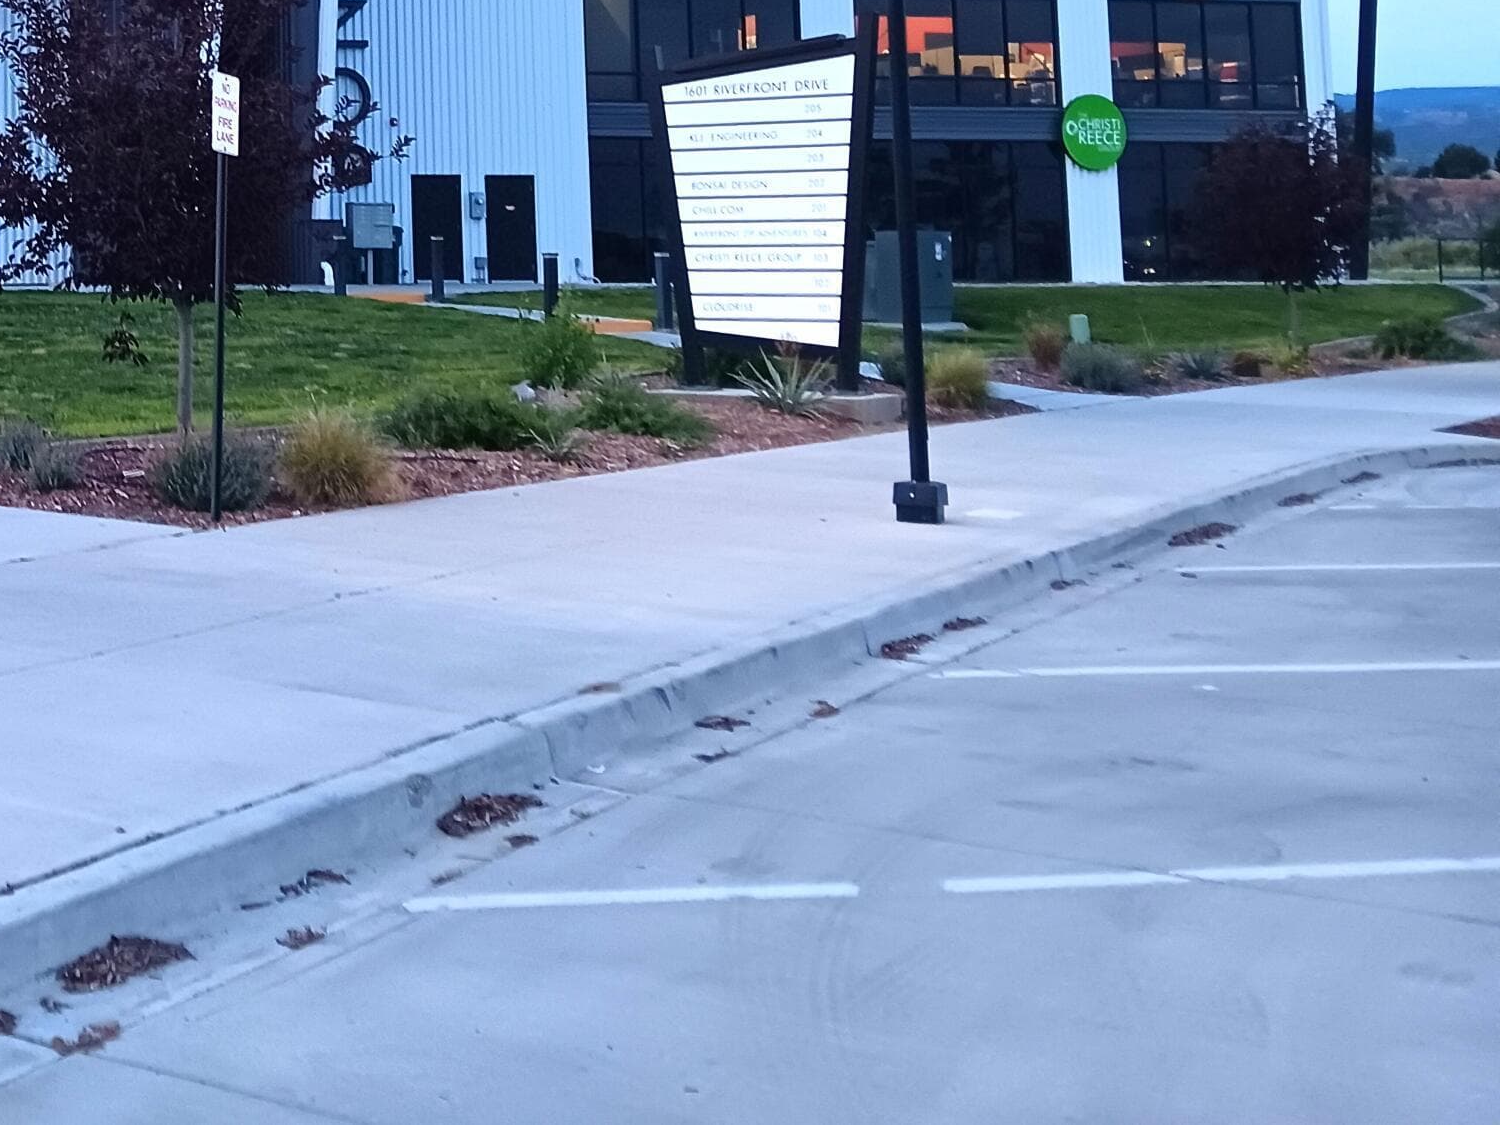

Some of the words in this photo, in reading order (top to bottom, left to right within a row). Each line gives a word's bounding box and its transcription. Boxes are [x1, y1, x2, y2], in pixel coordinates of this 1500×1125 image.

[222, 83, 231, 95] NO
[684, 86, 708, 97] 1601
[713, 81, 787, 96] RIVERFRONT
[794, 79, 829, 92] DRIVE
[215, 96, 237, 113] PARKING
[219, 116, 233, 130] FIRE
[1078, 118, 1121, 130] CHRISTI
[216, 131, 234, 145] LANE
[710, 131, 777, 142] ENGINEERING
[806, 129, 823, 139] 204
[1078, 130, 1121, 145] REECE
[691, 181, 727, 191] BONSAI
[731, 180, 769, 190] DESIGN
[767, 252, 803, 263] GROUP
